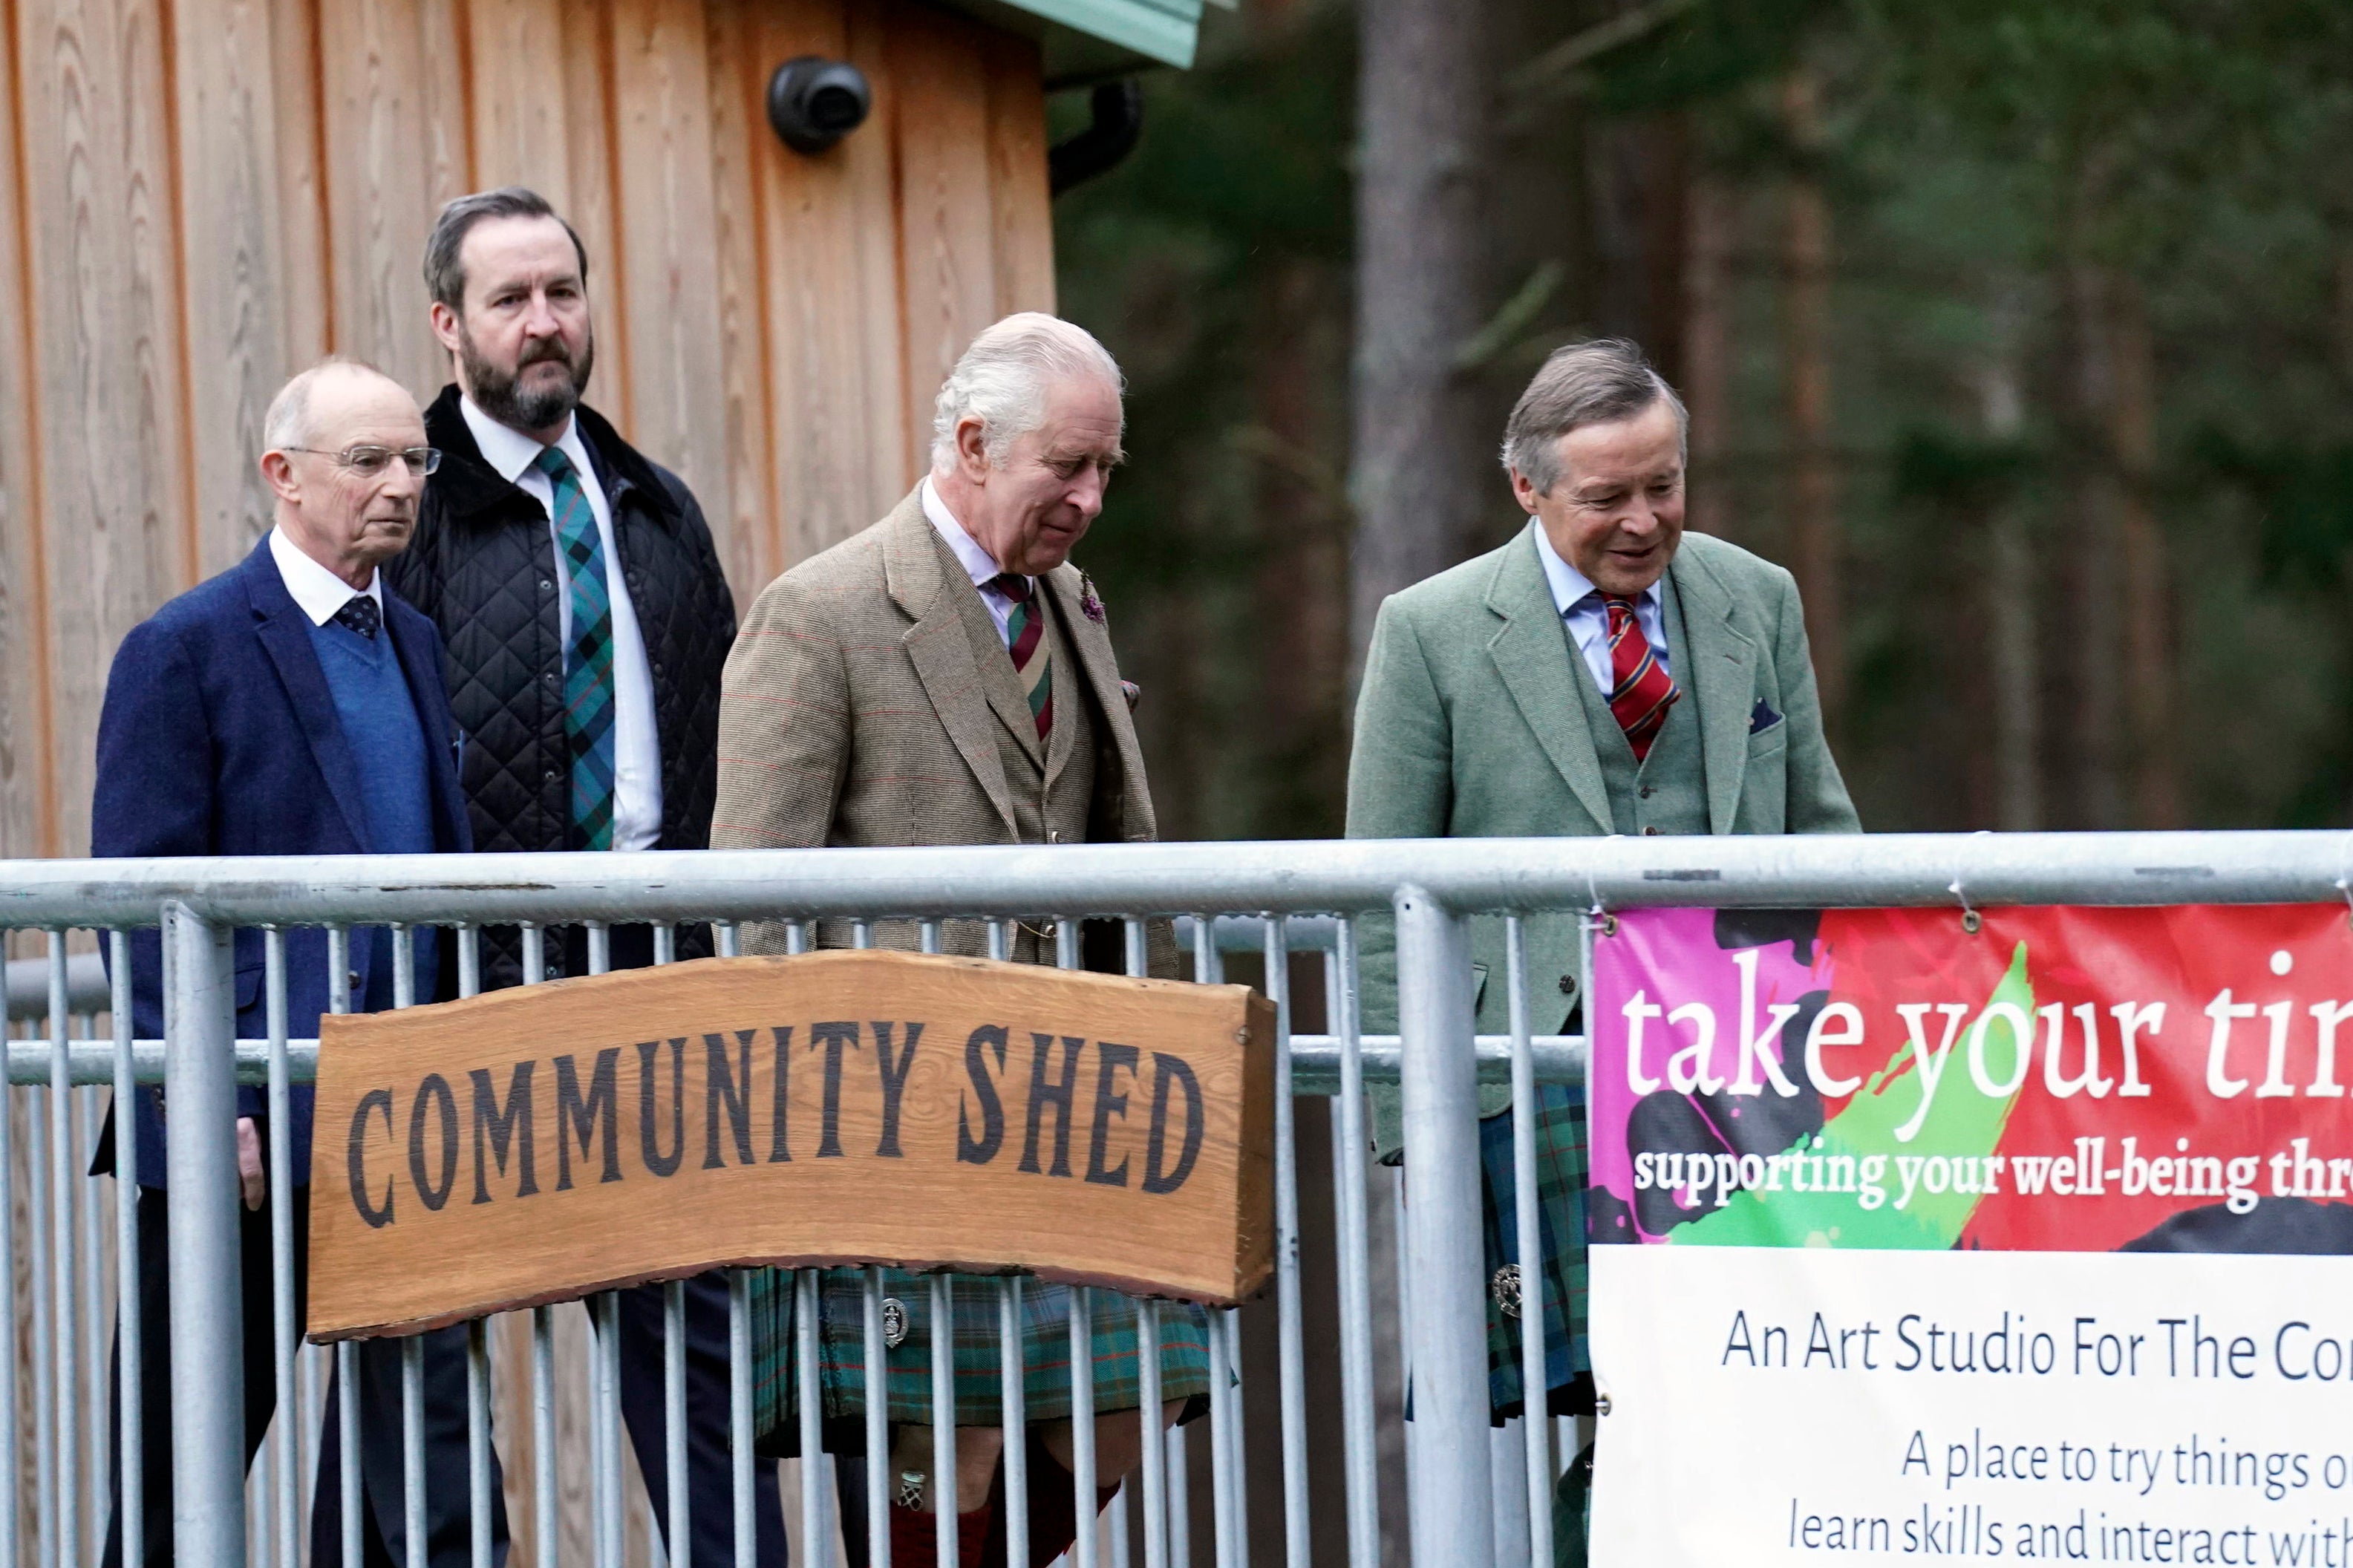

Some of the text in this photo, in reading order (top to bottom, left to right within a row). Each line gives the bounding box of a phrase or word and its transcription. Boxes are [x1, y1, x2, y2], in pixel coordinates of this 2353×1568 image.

[1622, 948, 1864, 1098] take
[1893, 999, 2167, 1143] your
[347, 1020, 1205, 1229] COMMUNITY SHED
[1634, 1136, 2353, 1215] supporting your well-being thr
[1722, 1310, 2353, 1382] An Art Studio For The Co
[1902, 1428, 2353, 1501] A place to try things o
[1789, 1498, 1889, 1552] learn
[1903, 1503, 2003, 1556] skills
[2017, 1509, 2089, 1559] and
[2101, 1513, 2256, 1566] interact
